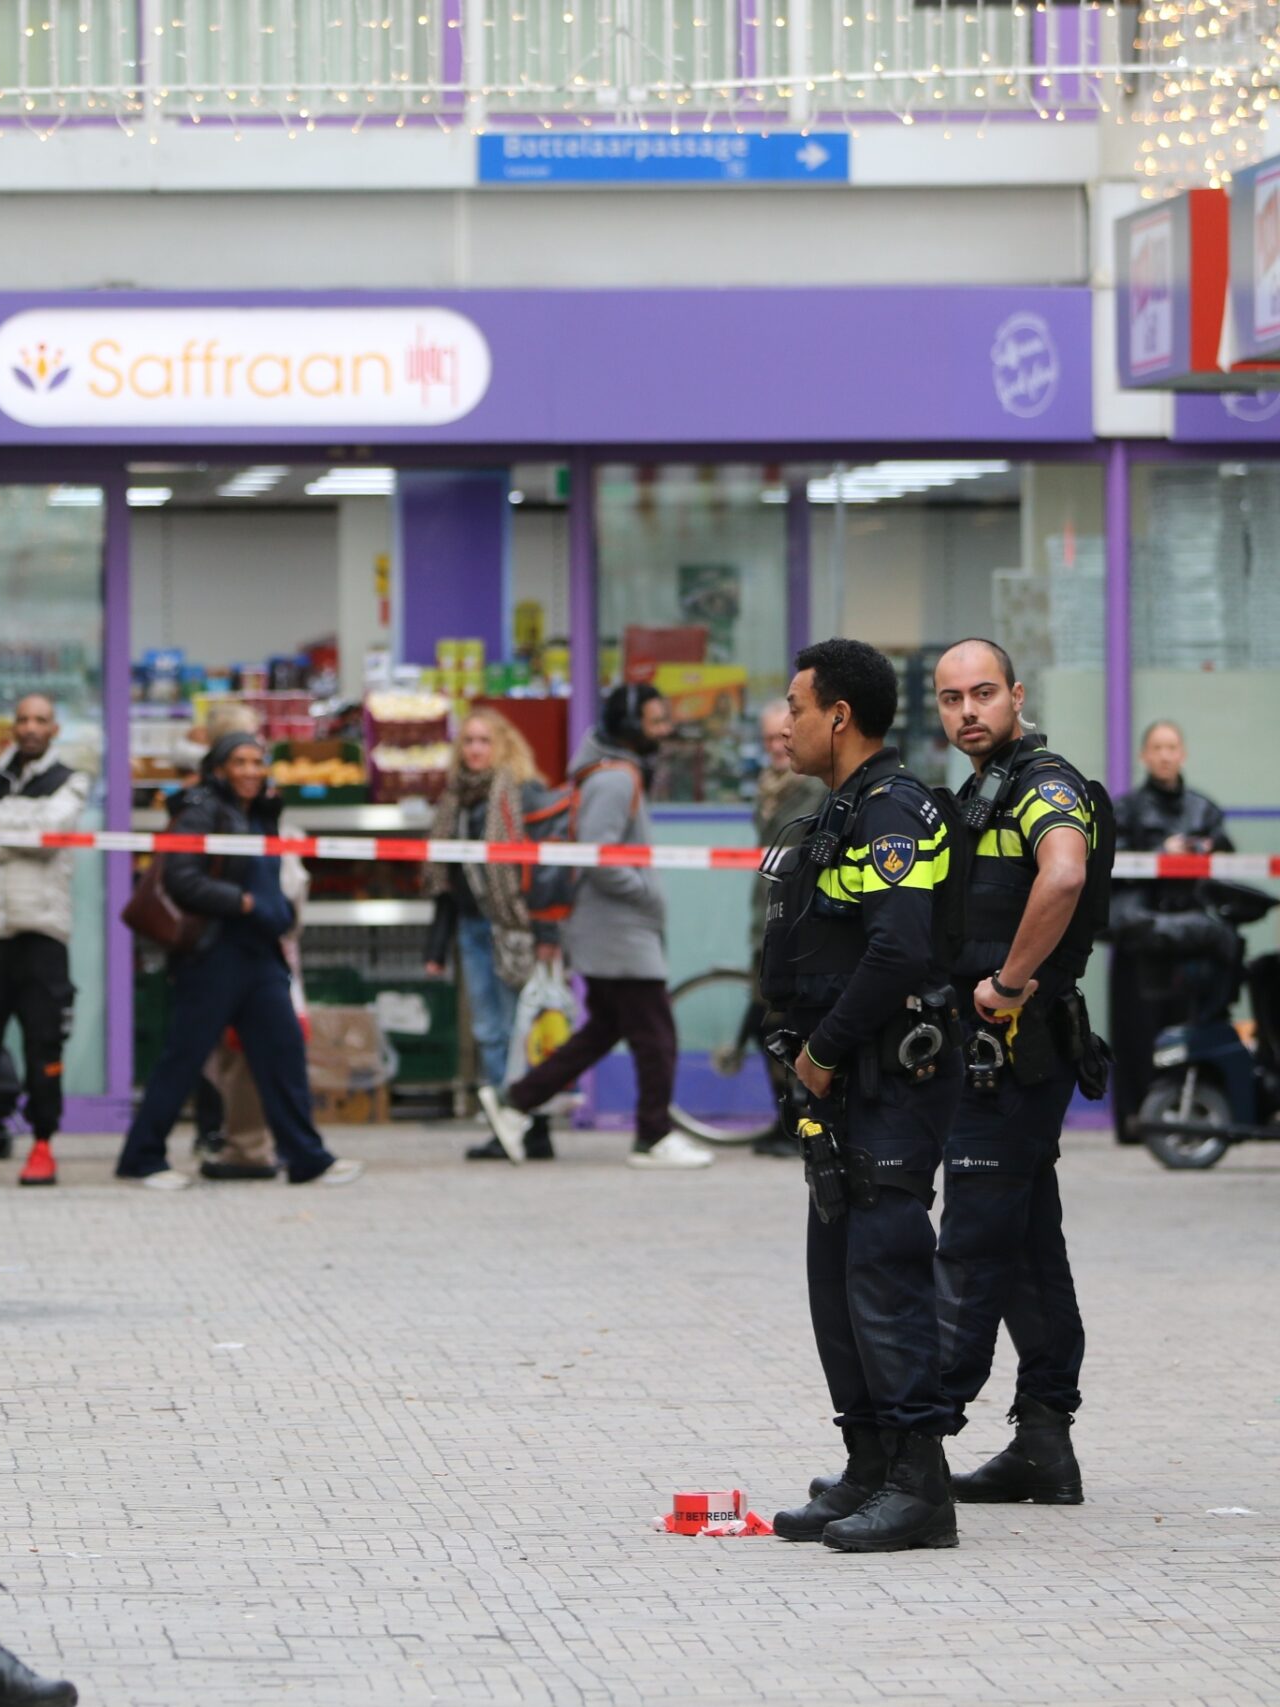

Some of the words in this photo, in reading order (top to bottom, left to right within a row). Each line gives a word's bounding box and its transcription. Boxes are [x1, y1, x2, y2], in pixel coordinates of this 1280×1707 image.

[503, 136, 750, 161] Bottelaarpassage
[87, 339, 393, 399] Saffraan
[876, 839, 912, 851] POLITIE
